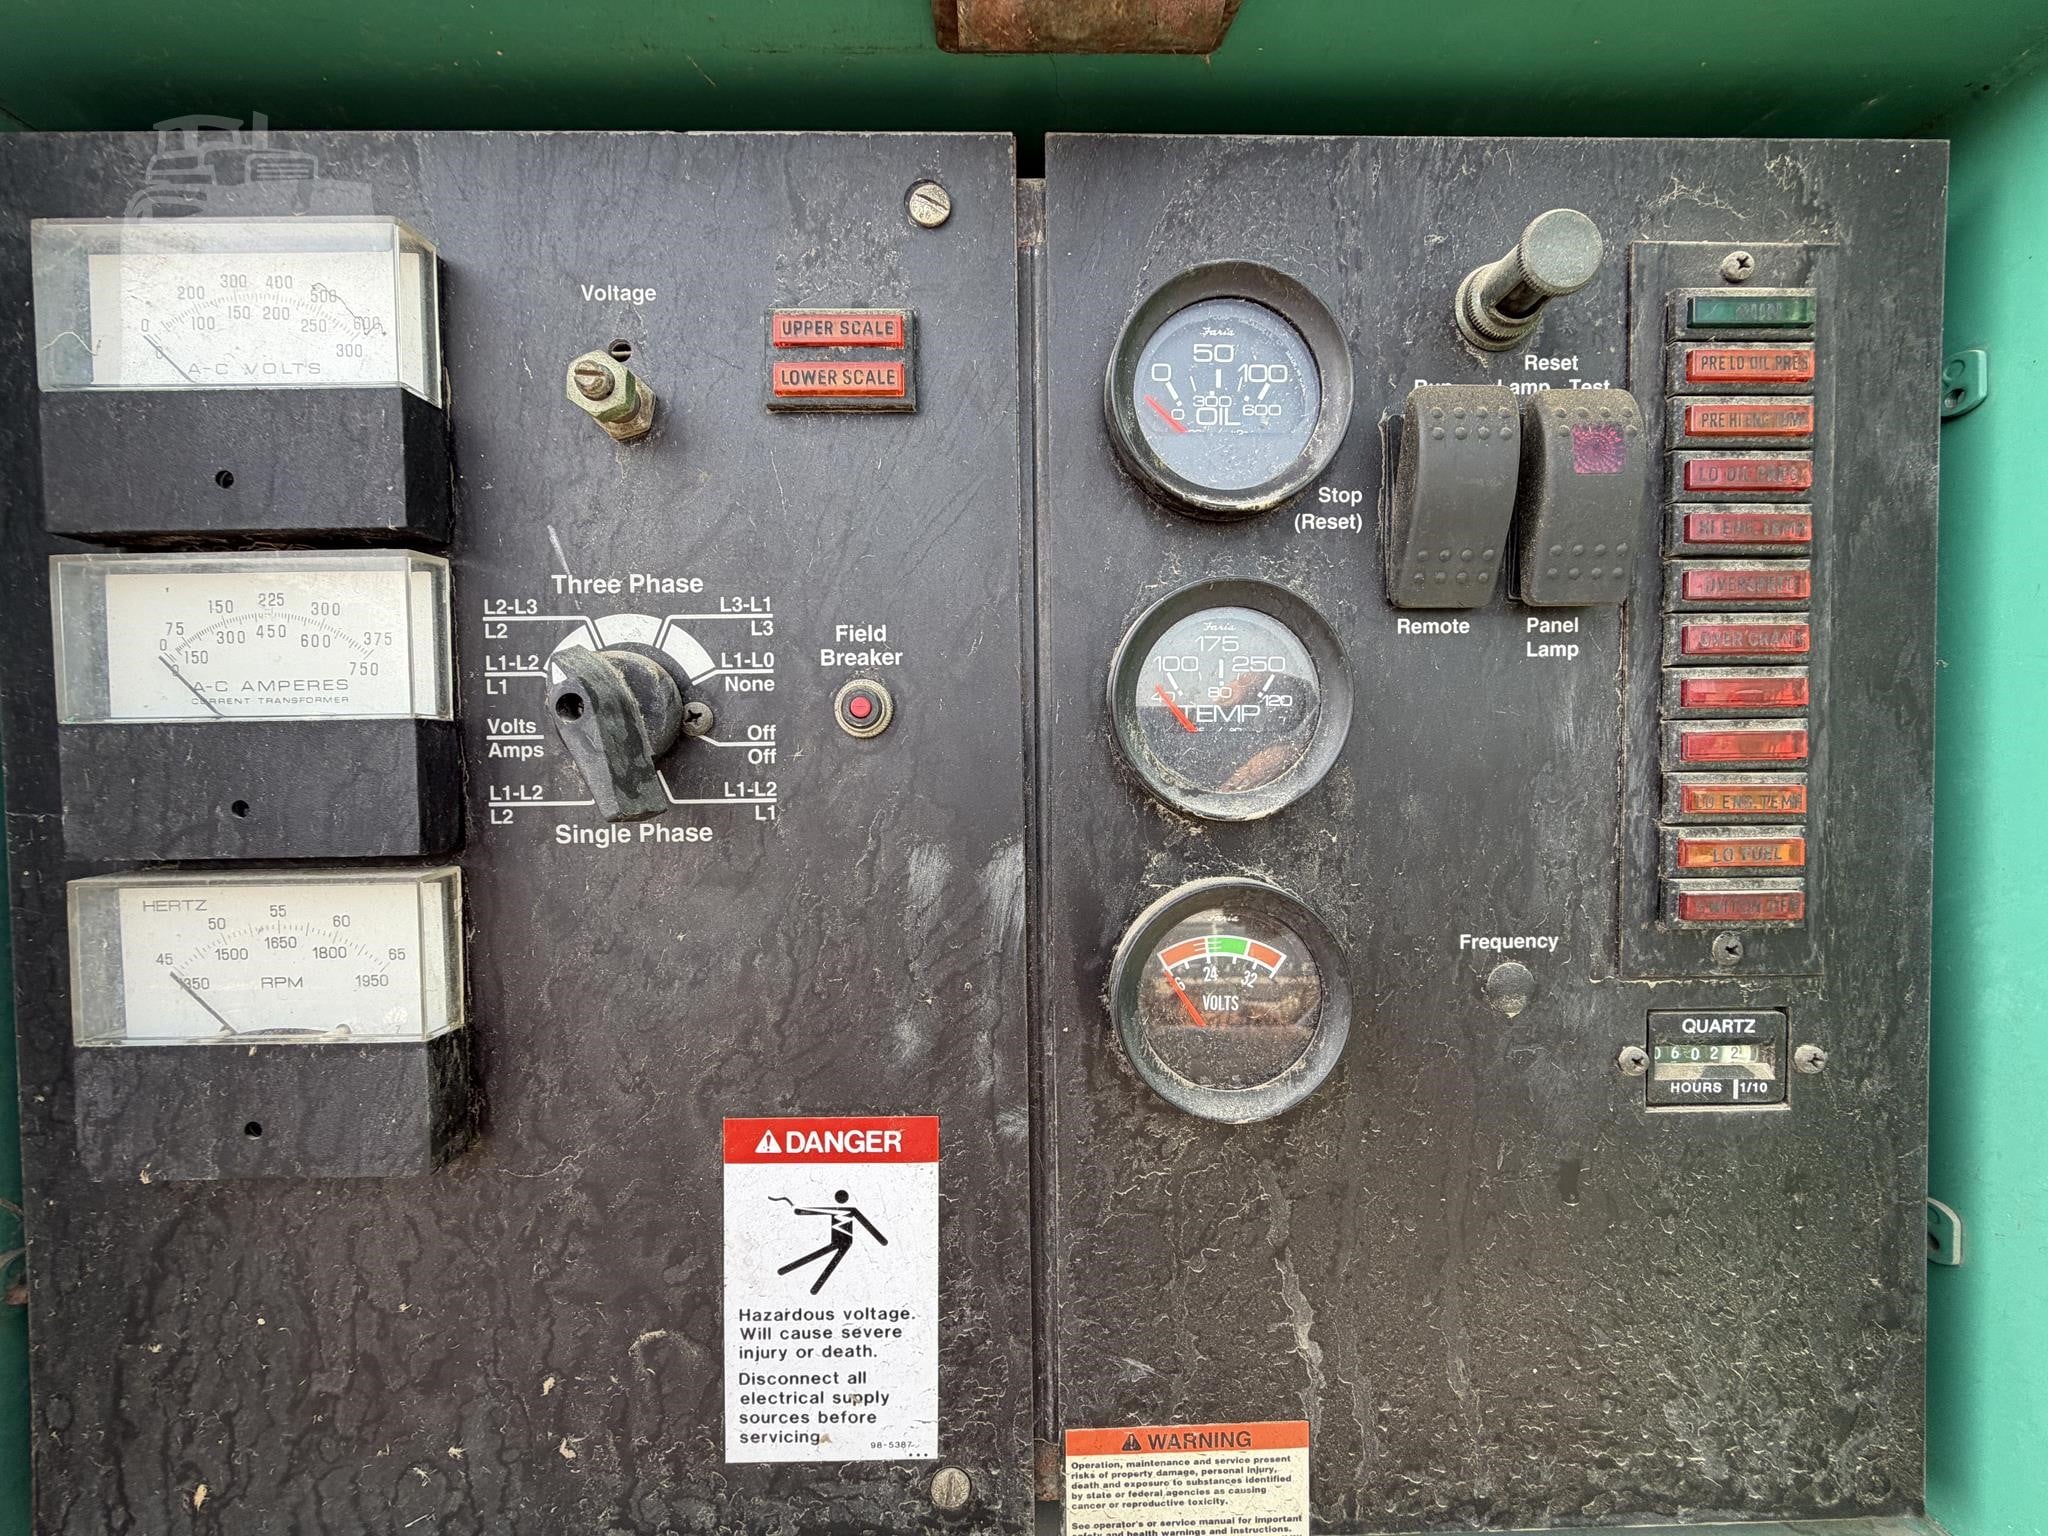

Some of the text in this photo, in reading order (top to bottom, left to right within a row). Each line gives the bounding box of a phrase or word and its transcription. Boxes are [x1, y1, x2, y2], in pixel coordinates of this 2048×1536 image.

[220, 274, 293, 290] 300 400
[581, 284, 657, 305] Voltage
[141, 319, 149, 332] 0
[177, 286, 205, 300] 200
[310, 288, 337, 304] 500
[191, 306, 363, 358] 100 150 200 250 300
[782, 319, 894, 336] UPPER SCALE
[1193, 343, 1234, 362] 50
[188, 362, 321, 374] A-C VOLTS
[1524, 354, 1579, 371] Reset
[1701, 355, 1745, 370] PRE LO
[781, 368, 896, 386] LOWER SCALE
[1151, 363, 1288, 383] 0 100
[1192, 395, 1232, 407] 300
[1242, 404, 1282, 416] 600
[1196, 407, 1241, 426] OIL
[1701, 412, 1726, 428] PRE
[1318, 487, 1363, 505] Stop
[1294, 514, 1363, 534] (Reset)
[551, 574, 704, 594] Three Phase
[208, 593, 340, 616] 150 225 300
[483, 599, 538, 615] L2-L3
[719, 597, 772, 613] L3-L1
[485, 624, 508, 639] L2
[750, 620, 774, 636] L3
[835, 624, 886, 642] Field
[1397, 619, 1470, 634] Remote
[1526, 618, 1579, 633] Panel
[159, 622, 392, 652] 0 75 375
[1195, 635, 1240, 652] 175
[184, 625, 378, 676] 150 300 450 600 750
[820, 648, 903, 667] Breaker
[1526, 642, 1579, 660] Lamp
[485, 655, 539, 671] L1-L2
[721, 652, 774, 669] L1-L0
[1152, 655, 1286, 672] 100 250
[241, 679, 349, 692] AMPERES
[487, 680, 508, 695] L1
[724, 676, 775, 692] None
[258, 696, 349, 704] TRANSFORMER
[1208, 687, 1293, 707] 80 120
[487, 719, 537, 734] Volts
[747, 725, 776, 741] Off
[488, 743, 545, 760] Amps
[748, 749, 777, 764] Off
[489, 785, 543, 801] L1-L2
[724, 782, 777, 797] L1-L2
[490, 810, 514, 825] L2
[754, 805, 777, 821] L1
[555, 824, 713, 848] Single Phase
[1712, 847, 1782, 862] LO FUEL
[142, 900, 208, 912] HERTZ
[270, 905, 351, 928] 55 60
[156, 917, 406, 966] 45 50 65
[1460, 934, 1559, 951] Frequency
[215, 936, 389, 988] 1500 1650 1800 1950
[261, 976, 303, 988] RPM
[1203, 966, 1258, 988] 24 32
[1202, 995, 1239, 1011] VOLTS
[1682, 1019, 1755, 1033] QUARTZ
[1671, 1082, 1722, 1093] HOURS
[786, 1130, 902, 1153] DANGER
[739, 1307, 916, 1322] Hazardous voltage.
[740, 1327, 902, 1340] Will cause severe
[739, 1345, 877, 1361] injury or death.
[739, 1371, 866, 1385] Disconnect all
[740, 1391, 889, 1406] electrical supply
[740, 1411, 877, 1424] sources before
[1148, 1431, 1251, 1450] WARNING
[1071, 1462, 1123, 1470] Operation,
[1126, 1460, 1190, 1468] maintenance
[1253, 1456, 1291, 1464] present
[1111, 1470, 1152, 1479] property
[1156, 1469, 1198, 1477] damage,
[1201, 1467, 1243, 1476] personal
[1124, 1480, 1169, 1488] exposure
[1186, 1478, 1242, 1486] substances
[1246, 1475, 1292, 1483] identified
[1071, 1492, 1083, 1500] by
[1086, 1491, 1111, 1499] state
[1166, 1489, 1210, 1497] agencies
[1228, 1486, 1267, 1494] causing
[1122, 1500, 1184, 1509] reproductive
[1188, 1498, 1228, 1506] toxicity.
[1071, 1522, 1091, 1530] See
[1093, 1521, 1144, 1530] operator's
[1160, 1519, 1196, 1527] service
[1199, 1517, 1235, 1525] manual
[1255, 1515, 1302, 1524] important
[1209, 1526, 1292, 1535] and instructions.
